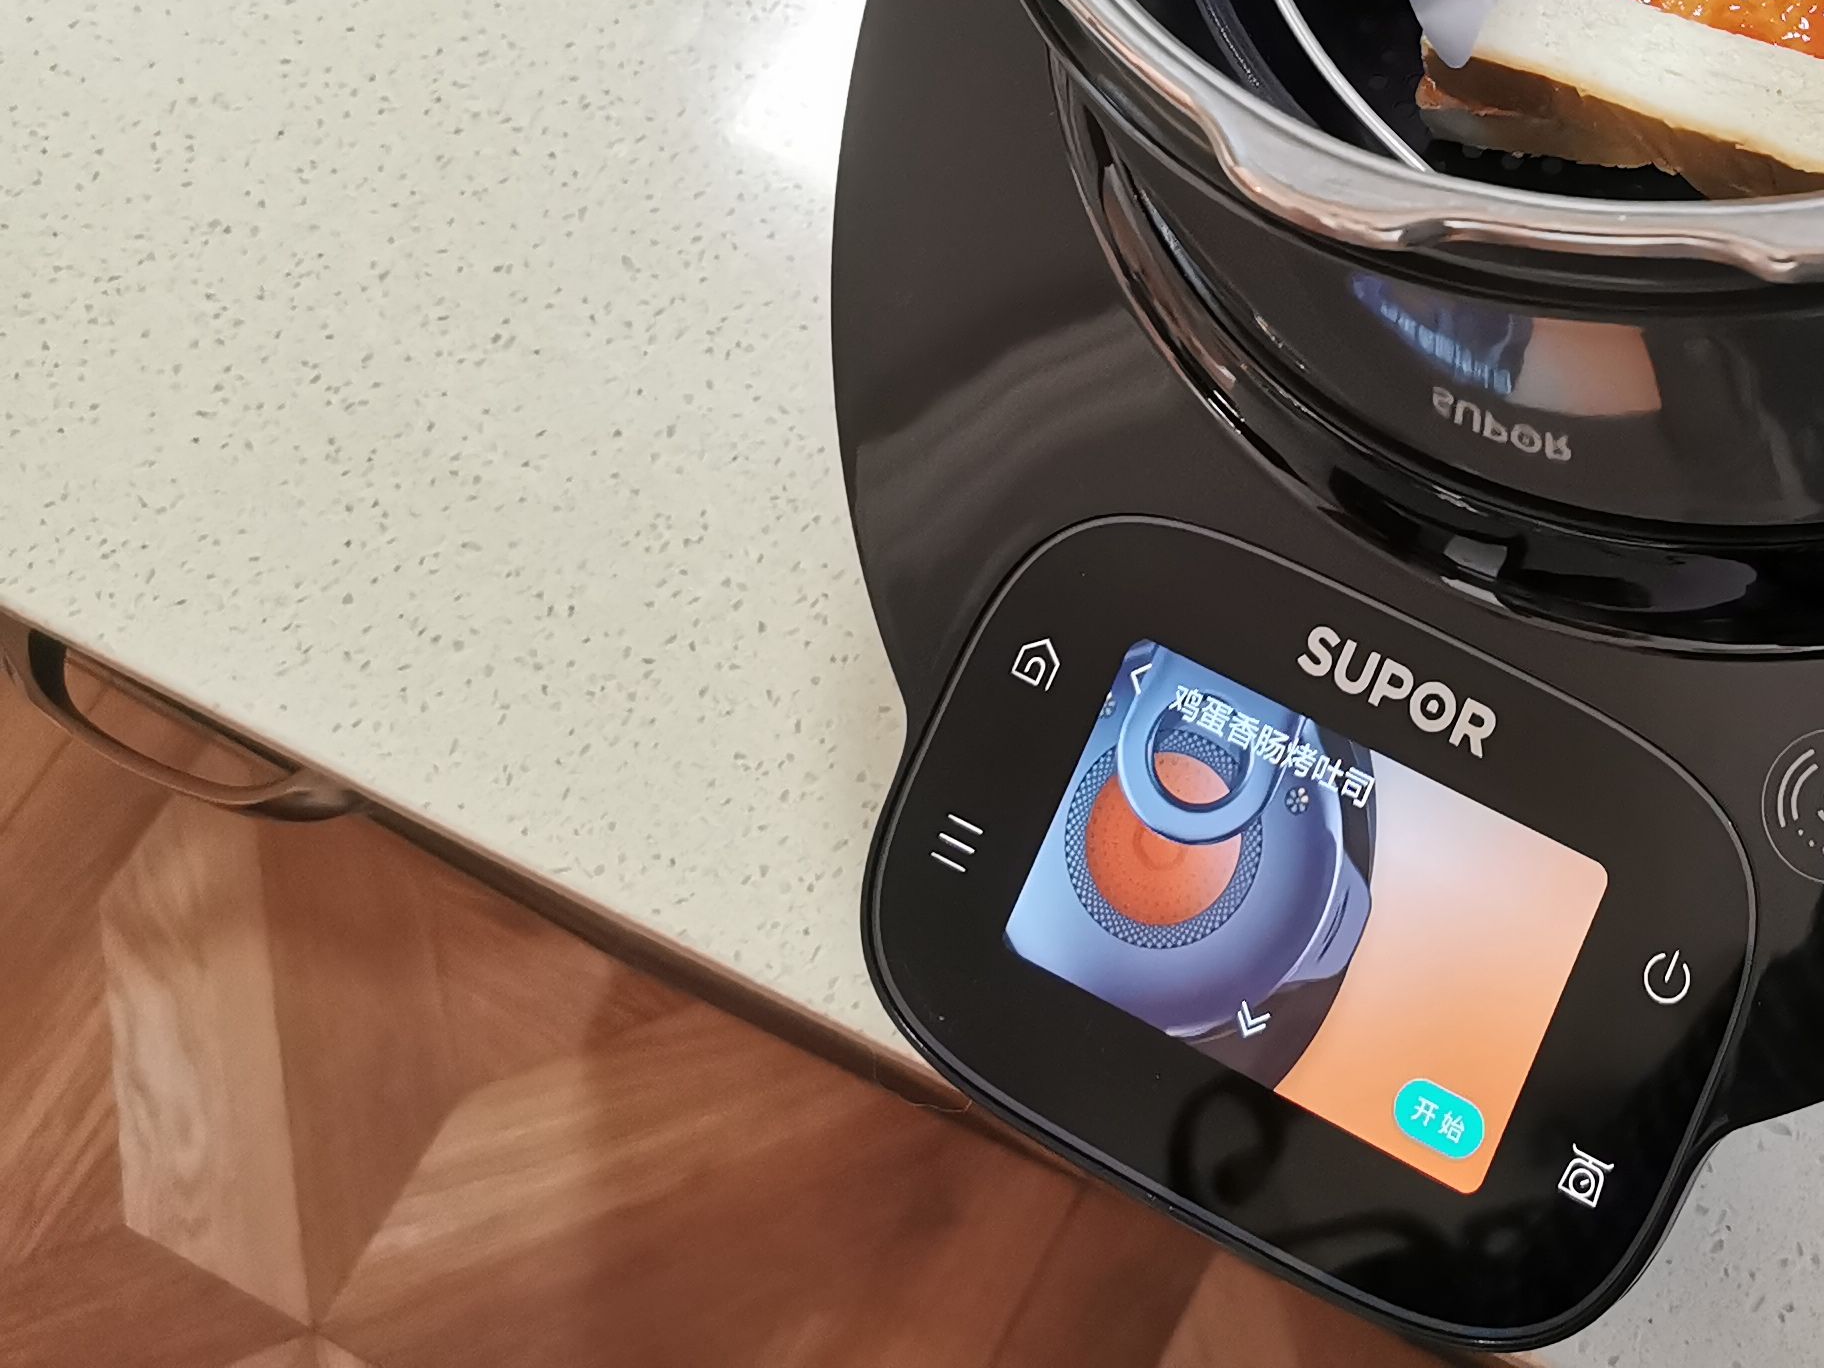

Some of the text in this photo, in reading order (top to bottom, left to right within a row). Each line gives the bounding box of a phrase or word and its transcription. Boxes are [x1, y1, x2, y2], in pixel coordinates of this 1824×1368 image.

[1168, 685, 1376, 809] 鸡蛋香肠烤吐司
[1297, 626, 1497, 759] SUPOR
[1410, 1096, 1465, 1144] 开始
